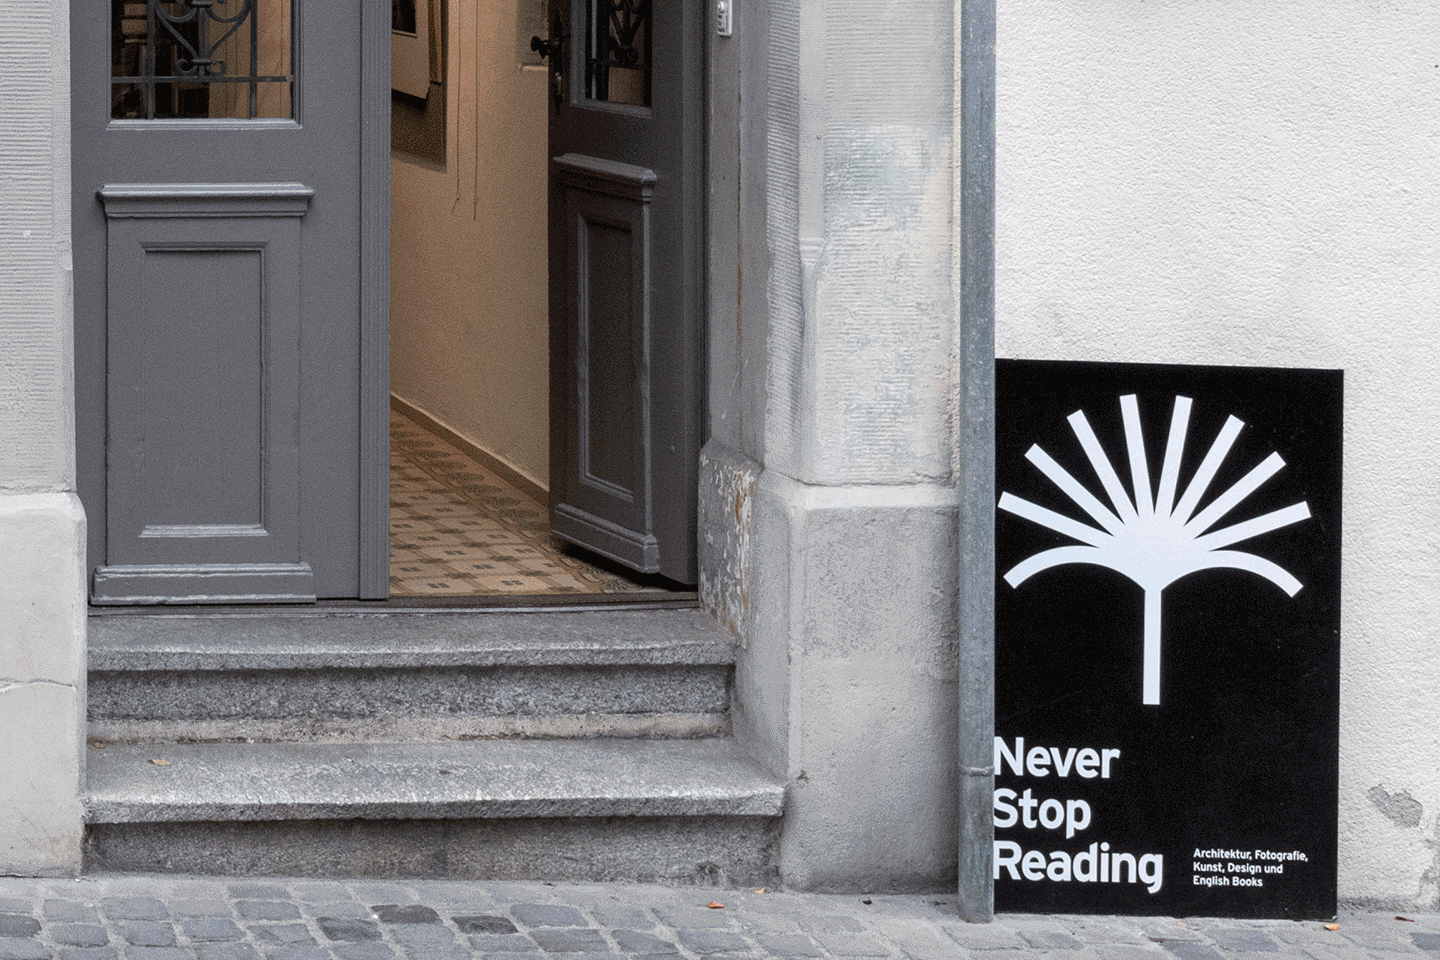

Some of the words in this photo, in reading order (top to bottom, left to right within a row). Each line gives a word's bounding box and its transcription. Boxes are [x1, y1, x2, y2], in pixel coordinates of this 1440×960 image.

[993, 736, 1121, 778] Never
[992, 788, 1092, 840] Stop
[992, 840, 1164, 894] Reading
[1193, 848, 1252, 860] Architektur,
[1254, 850, 1308, 862] Fotografie,
[1193, 862, 1226, 874] Kunst,
[1227, 862, 1262, 875] Design
[1264, 864, 1284, 874] und
[1192, 875, 1230, 888] English
[1232, 876, 1264, 887] Books
